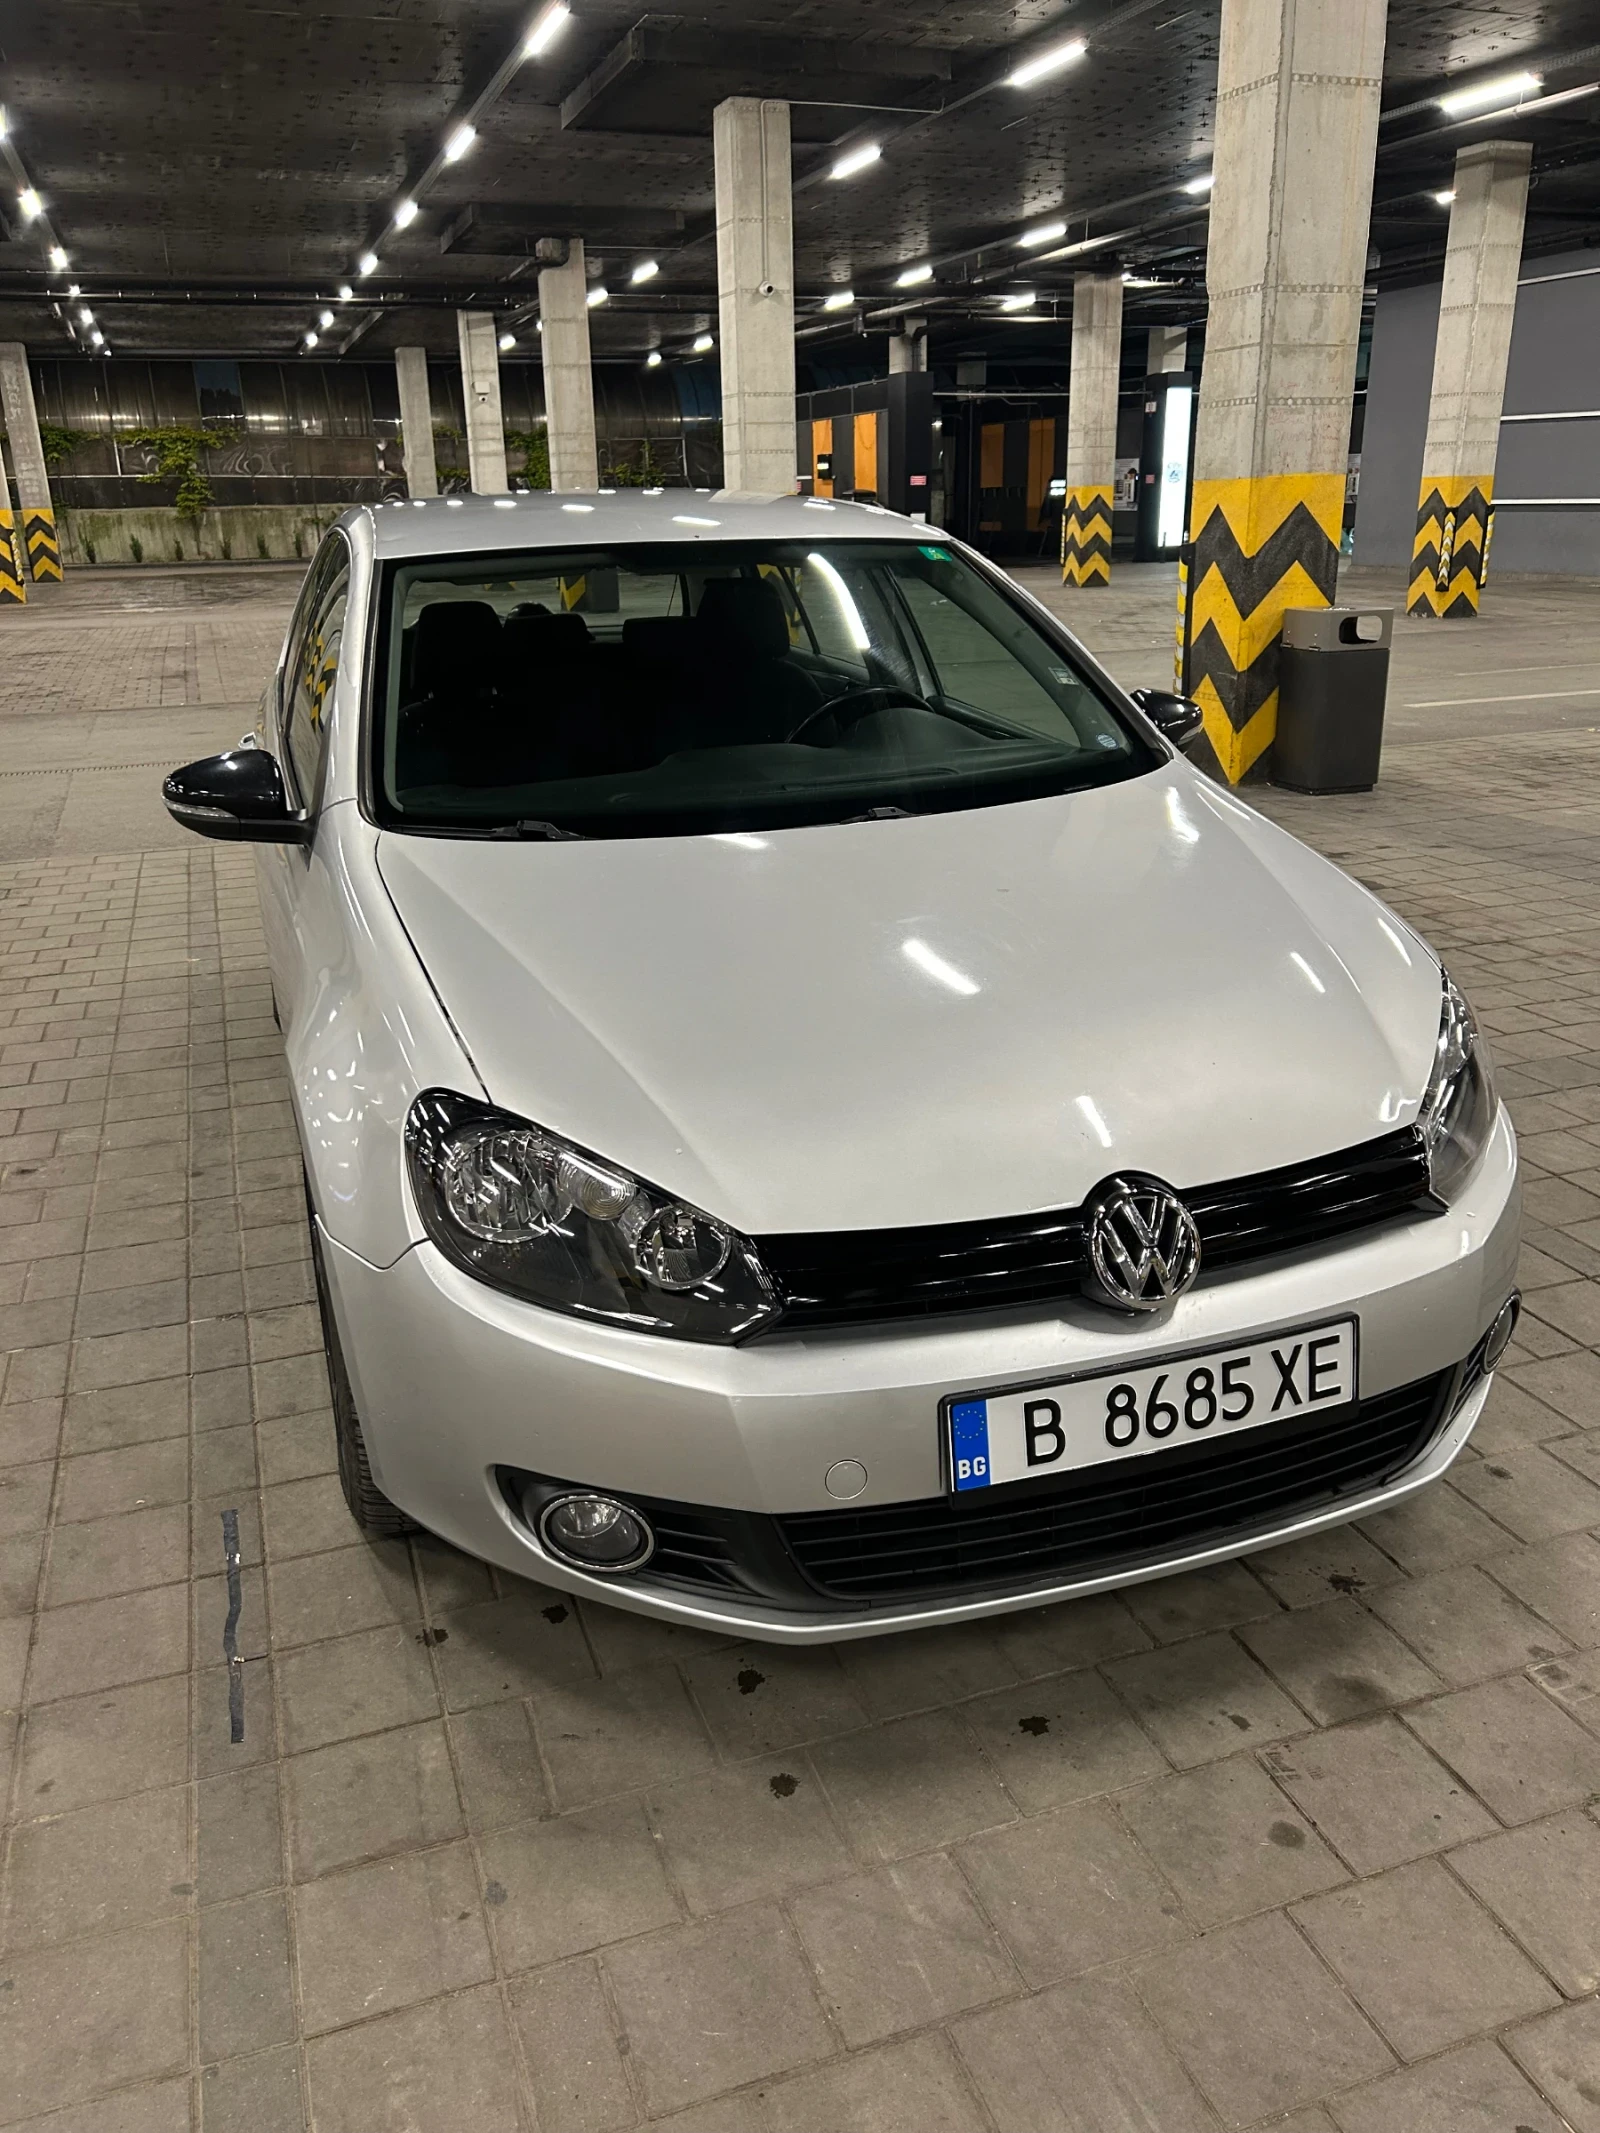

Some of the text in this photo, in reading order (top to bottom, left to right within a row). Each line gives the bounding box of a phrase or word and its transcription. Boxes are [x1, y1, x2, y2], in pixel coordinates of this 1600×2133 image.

[1023, 1335, 1341, 1467] B 8685 XE
[957, 1456, 987, 1480] BG
